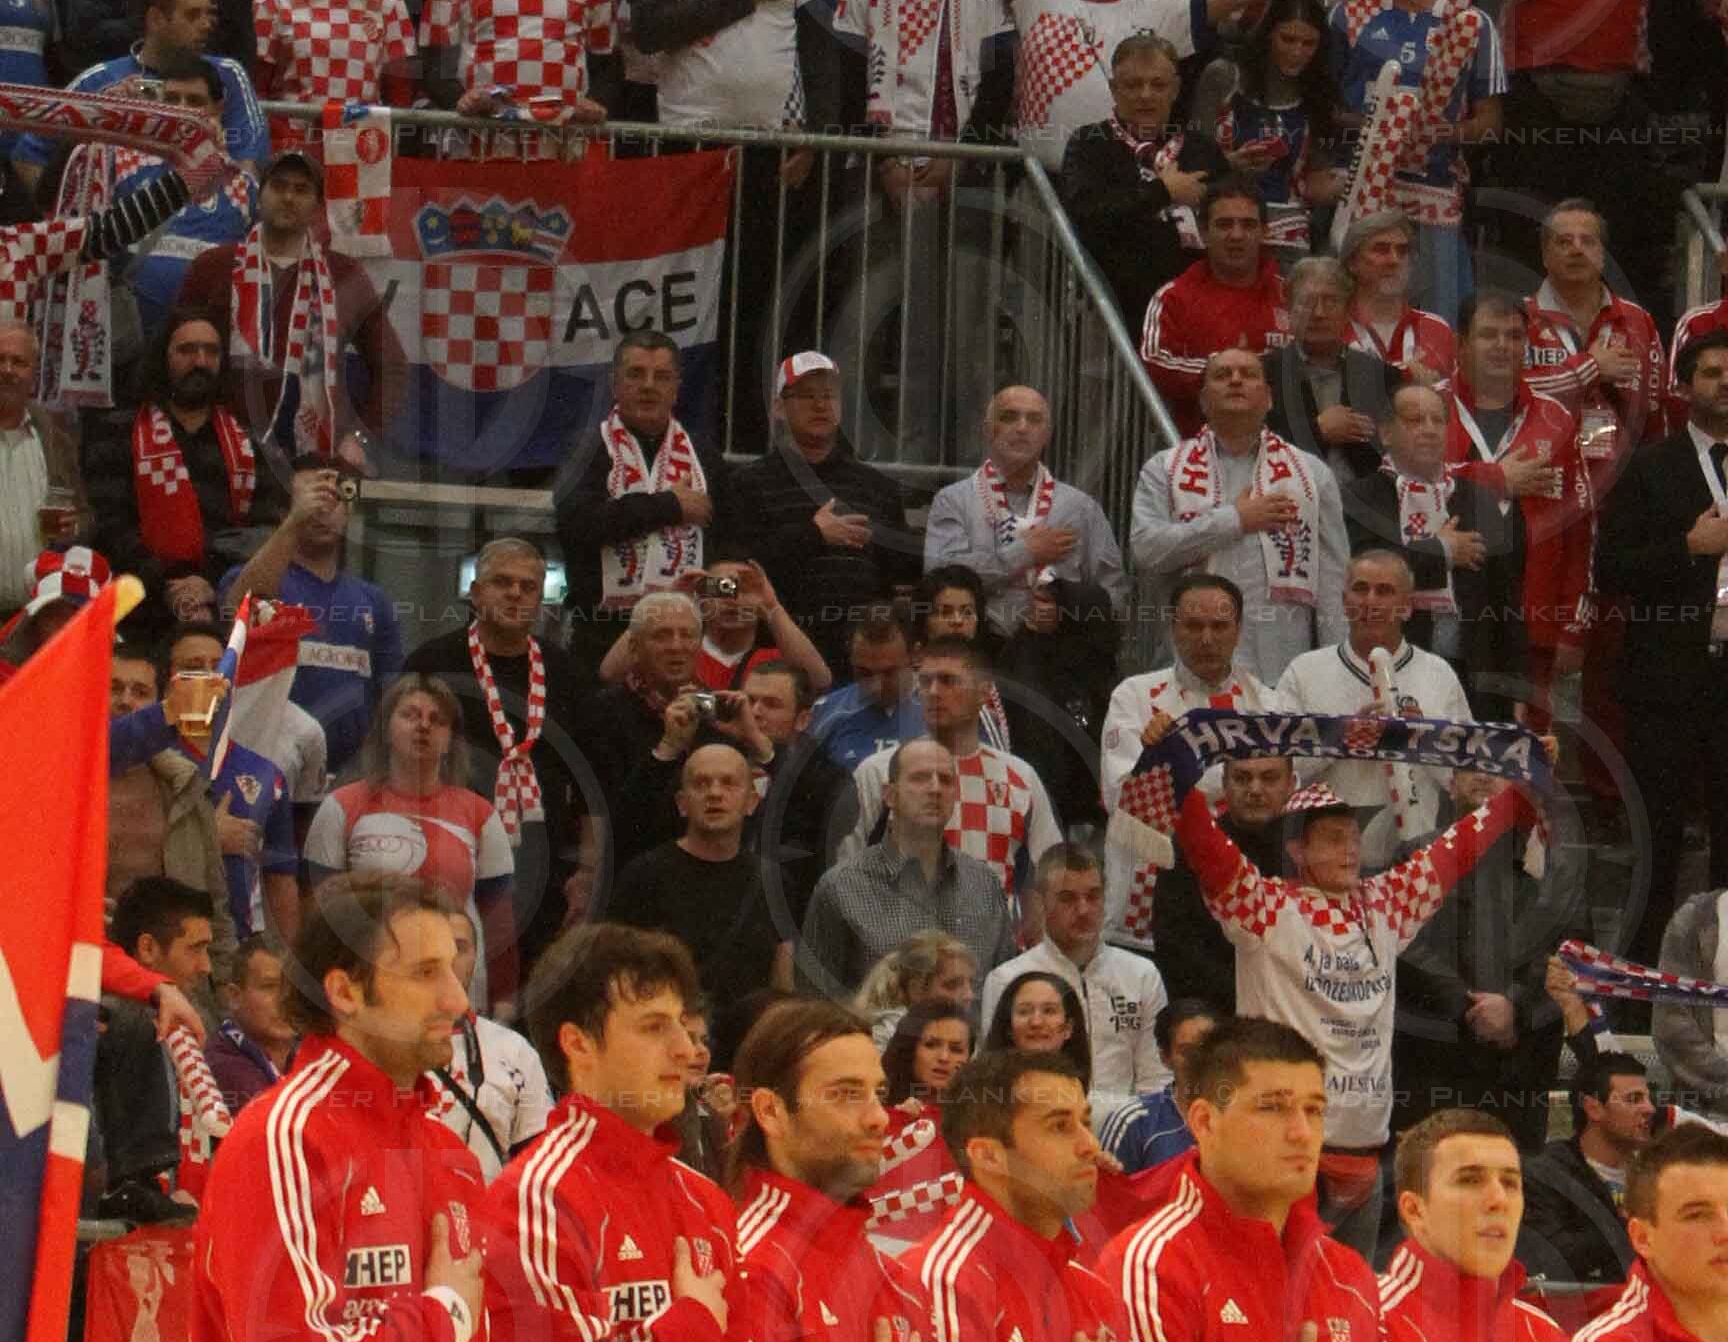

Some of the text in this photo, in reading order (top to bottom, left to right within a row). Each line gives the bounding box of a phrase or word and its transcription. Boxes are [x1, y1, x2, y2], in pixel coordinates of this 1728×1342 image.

[562, 271, 698, 342] ACE
[361, 1249, 406, 1284] HEP
[612, 1284, 667, 1323] HEP
